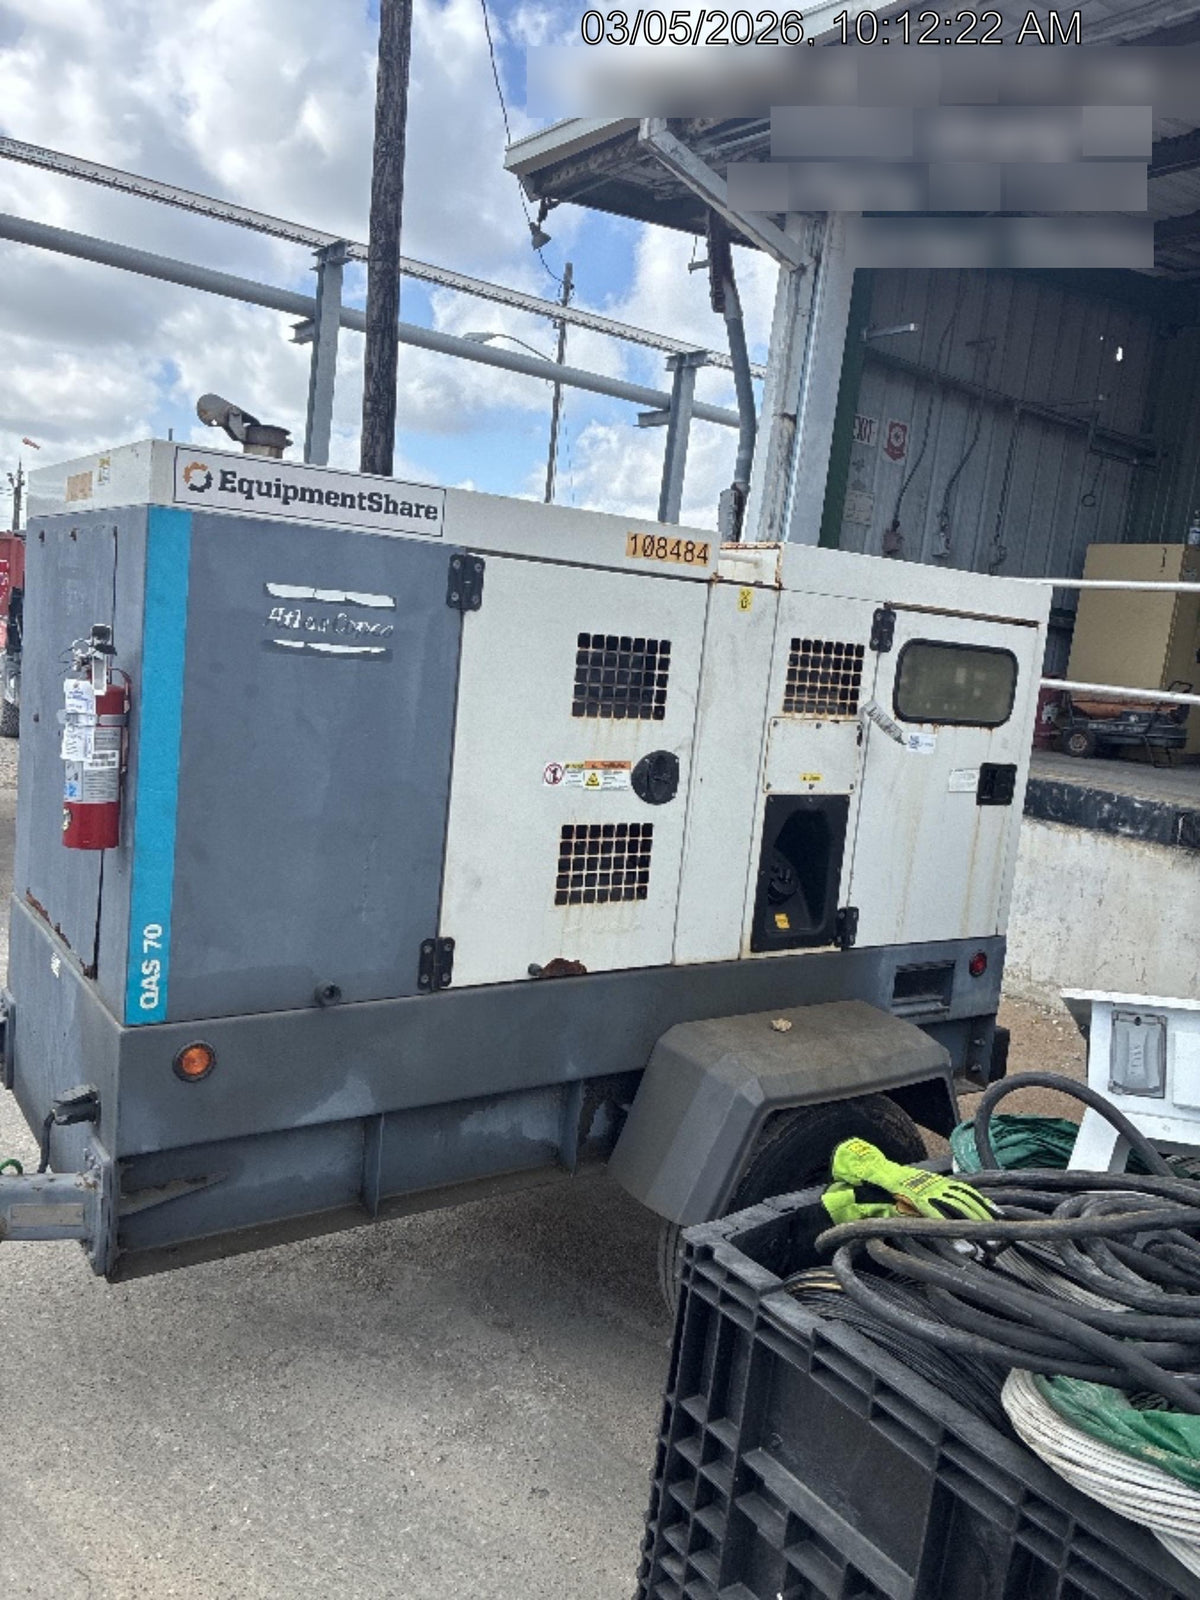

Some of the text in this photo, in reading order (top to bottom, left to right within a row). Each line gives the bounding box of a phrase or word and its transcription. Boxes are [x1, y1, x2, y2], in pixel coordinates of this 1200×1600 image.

[218, 468, 438, 521] EquipmentShare
[630, 533, 709, 564] 108484
[140, 923, 162, 1009] QAS 70
